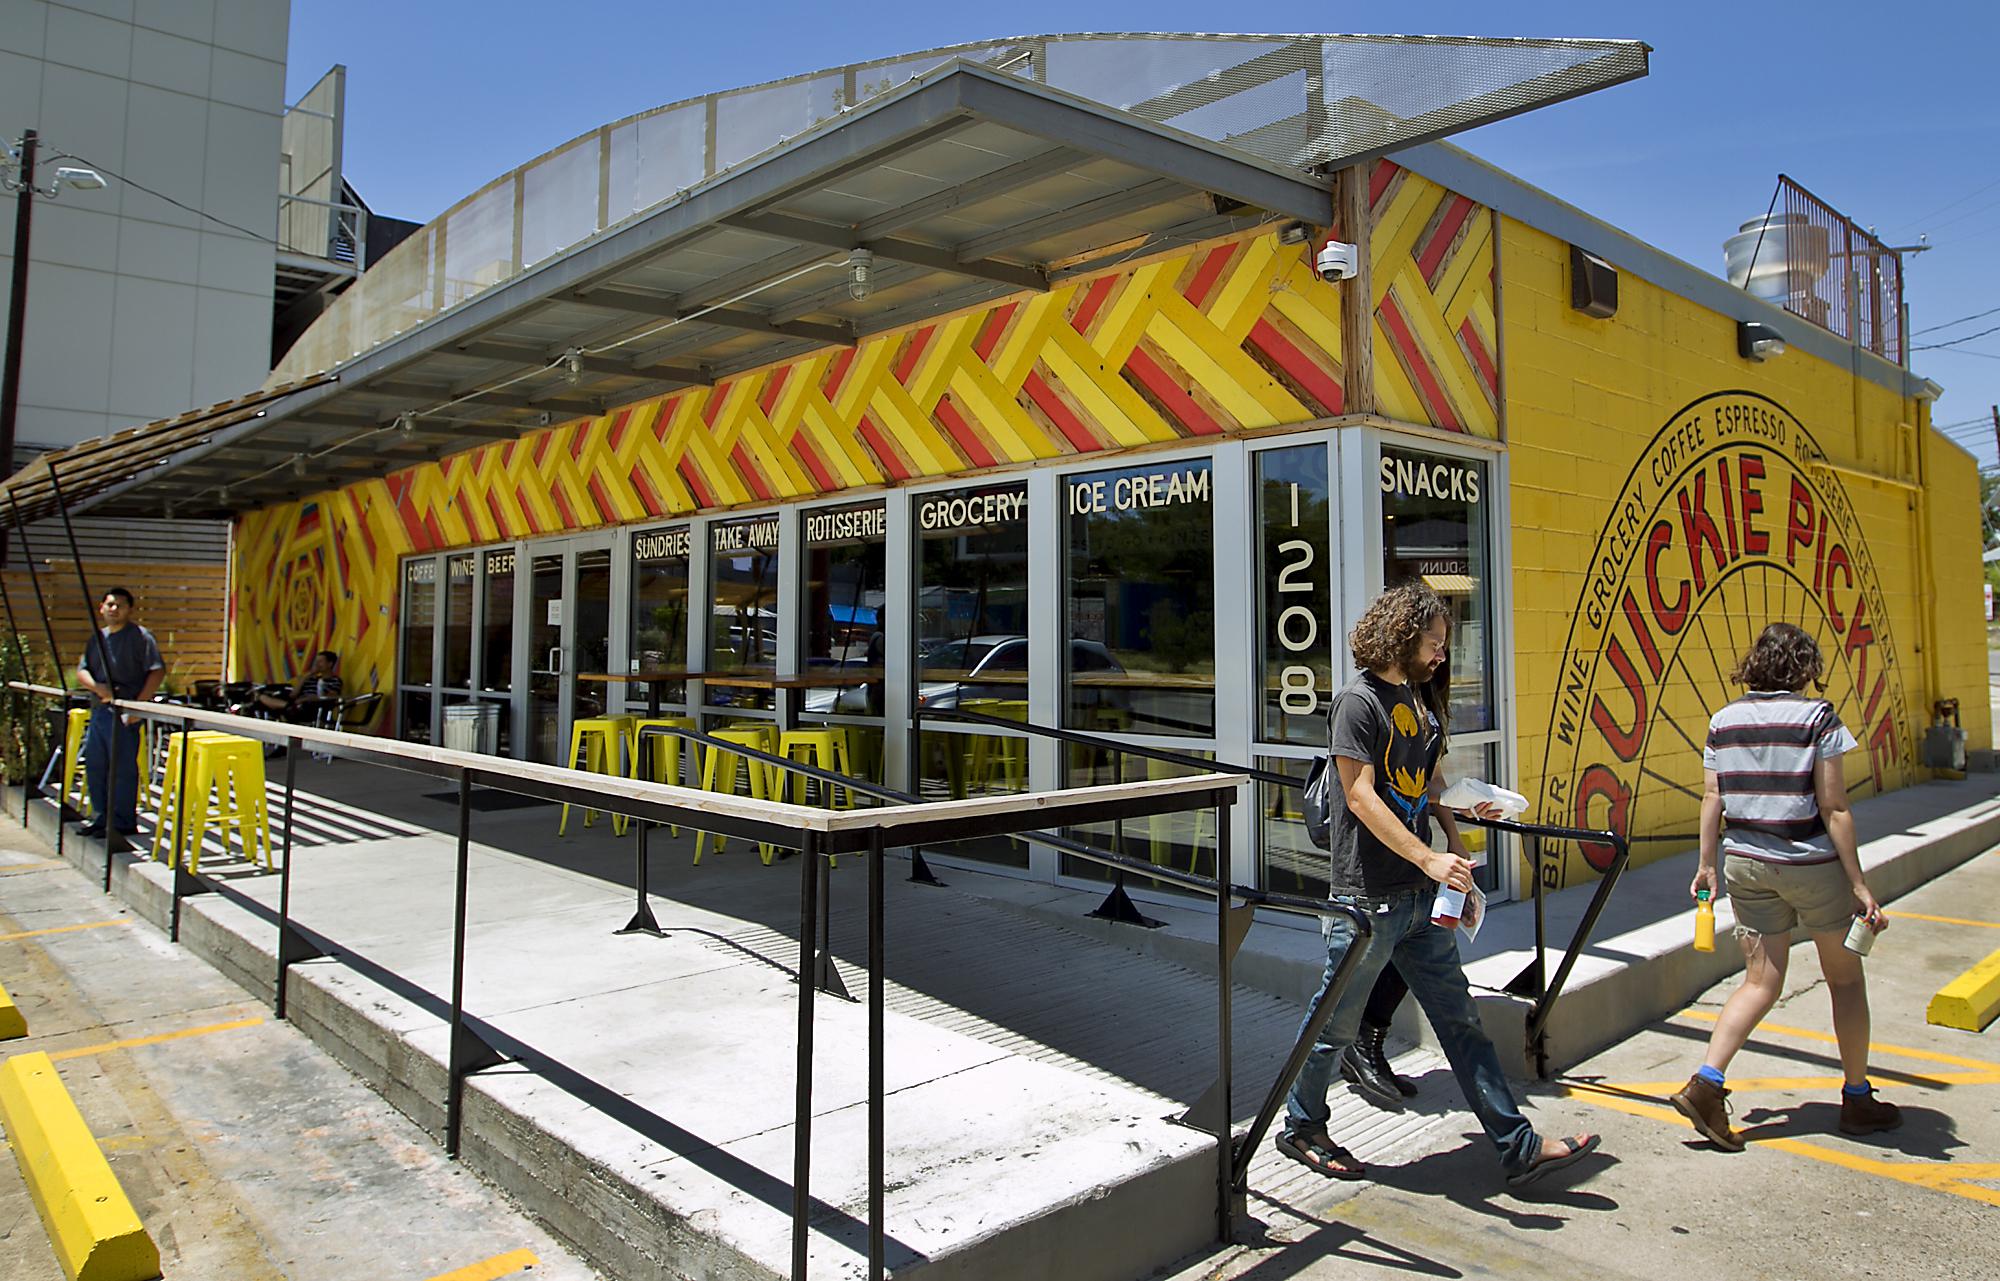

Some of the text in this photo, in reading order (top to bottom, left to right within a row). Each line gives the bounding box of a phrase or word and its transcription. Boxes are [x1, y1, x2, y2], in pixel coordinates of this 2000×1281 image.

[1069, 469, 1209, 515] ICE CREAM
[1380, 456, 1480, 503] SNACKS
[807, 508, 886, 542] ROTISSERIE
[919, 491, 1025, 530] GROCERY
[635, 532, 690, 560] SUNDRIES
[714, 521, 780, 552] TAKE AWAY
[408, 564, 436, 582] COFFE
[487, 555, 516, 574] BEER
[1277, 482, 1318, 716] 1208
[1543, 776, 1567, 889] BEER
[1558, 648, 1590, 747] WINE
[1587, 484, 1648, 631] GROCERY
[1652, 416, 1705, 487] COFFEE
[1715, 405, 1786, 447] ESPRESSO
[1856, 541, 1871, 585] ICE
[1575, 452, 1899, 874] QUICKIE PICKIE
